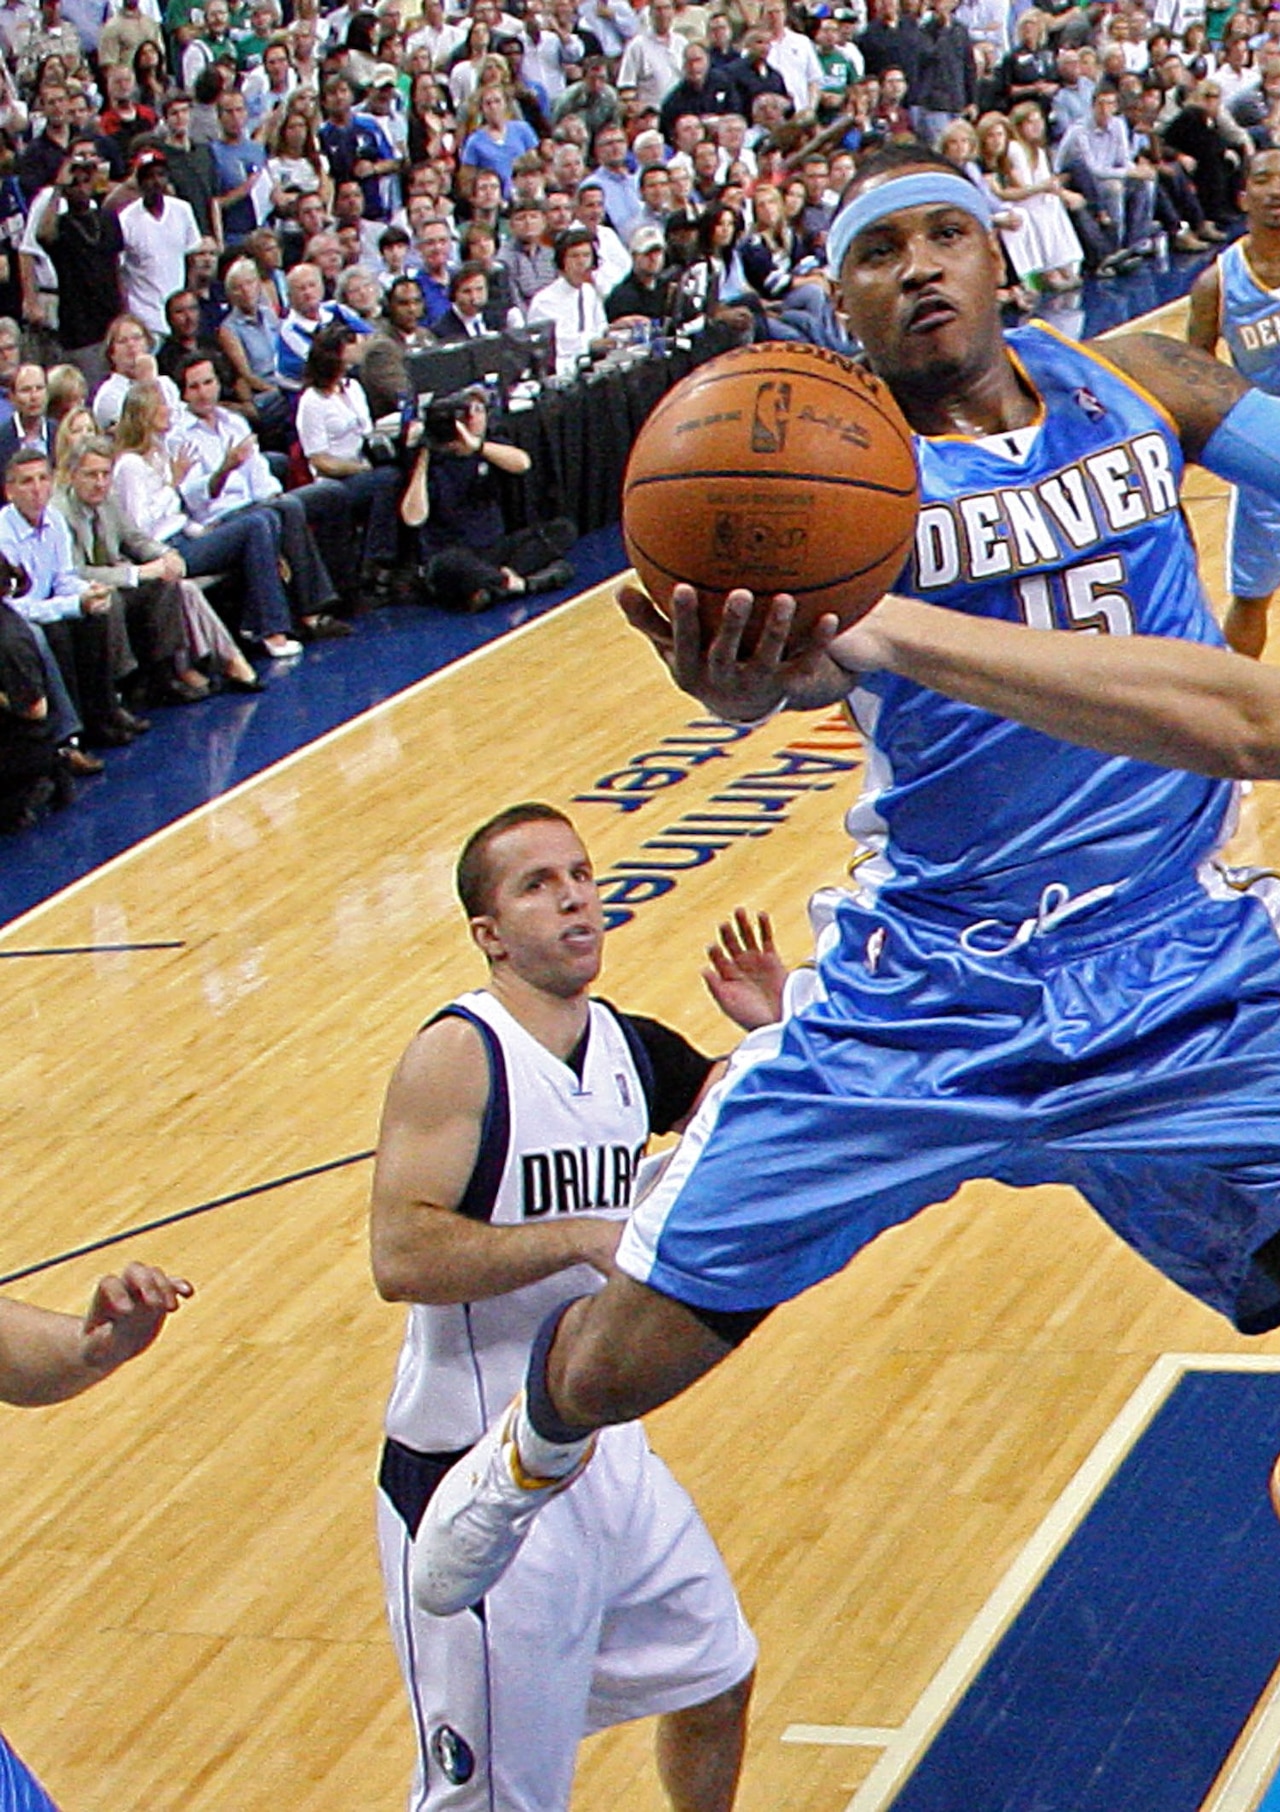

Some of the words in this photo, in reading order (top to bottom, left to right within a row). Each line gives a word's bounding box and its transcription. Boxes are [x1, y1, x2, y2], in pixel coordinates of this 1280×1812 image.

[914, 431, 1180, 592] DENVER
[1015, 553, 1137, 638] 15
[570, 718, 753, 812] nter
